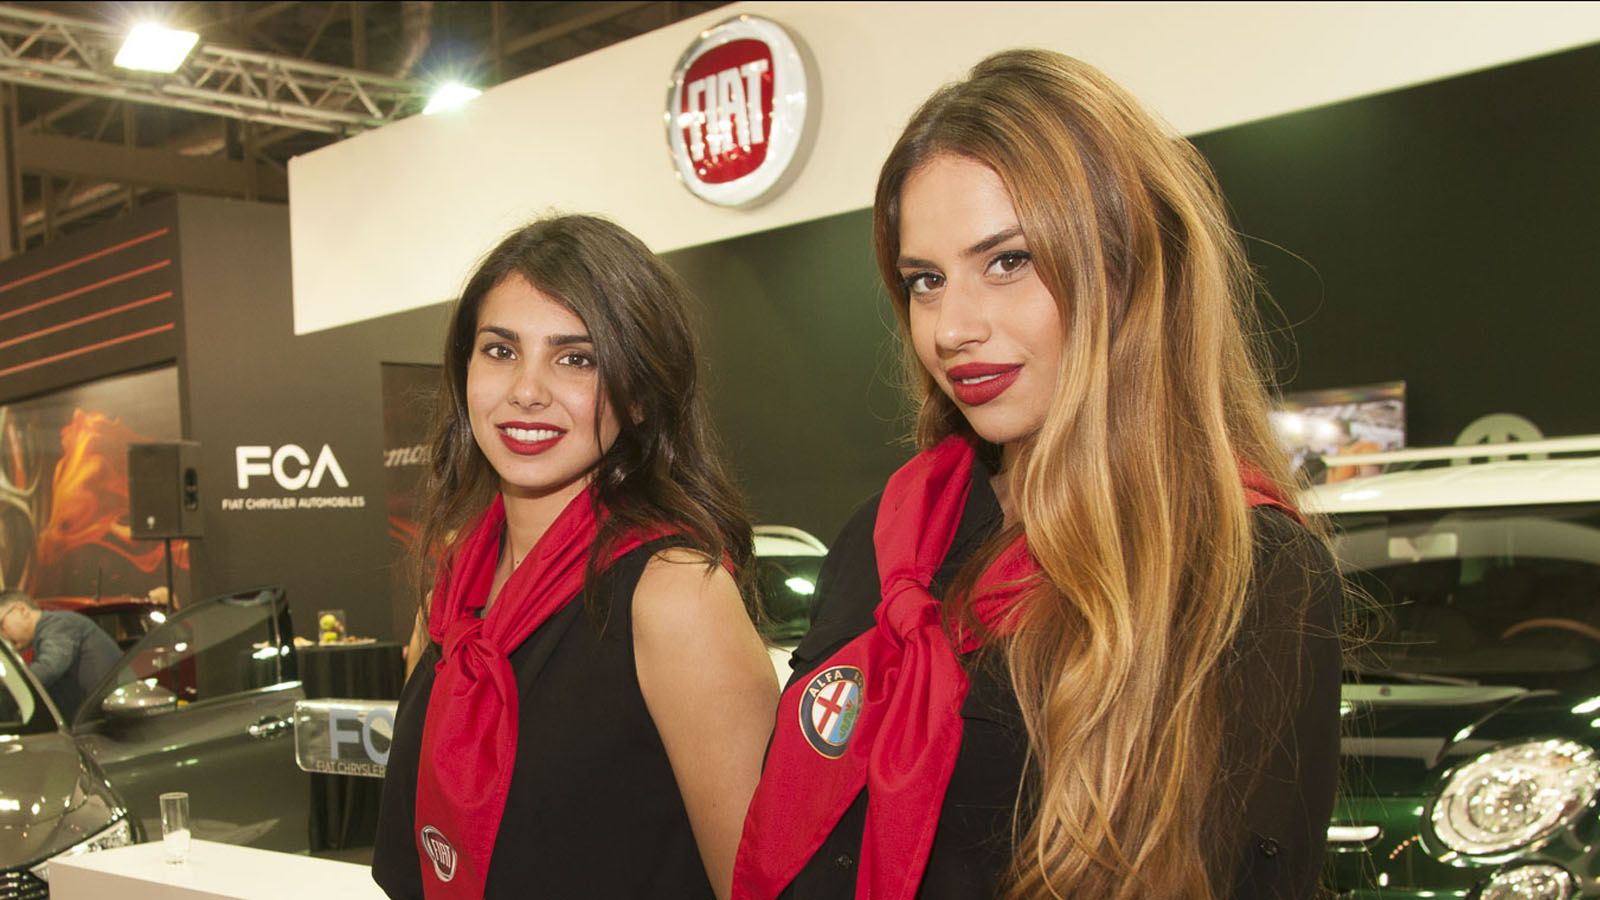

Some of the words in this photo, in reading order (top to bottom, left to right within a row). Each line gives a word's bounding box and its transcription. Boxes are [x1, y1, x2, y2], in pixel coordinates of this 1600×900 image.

[687, 59, 769, 162] FIAT
[235, 443, 349, 490] FCA
[222, 498, 244, 510] FIAT
[245, 497, 296, 510] CHRYSLER
[298, 496, 366, 508] AUTOMOBILES
[809, 670, 843, 698] ALFA
[430, 838, 451, 869] FIAT
